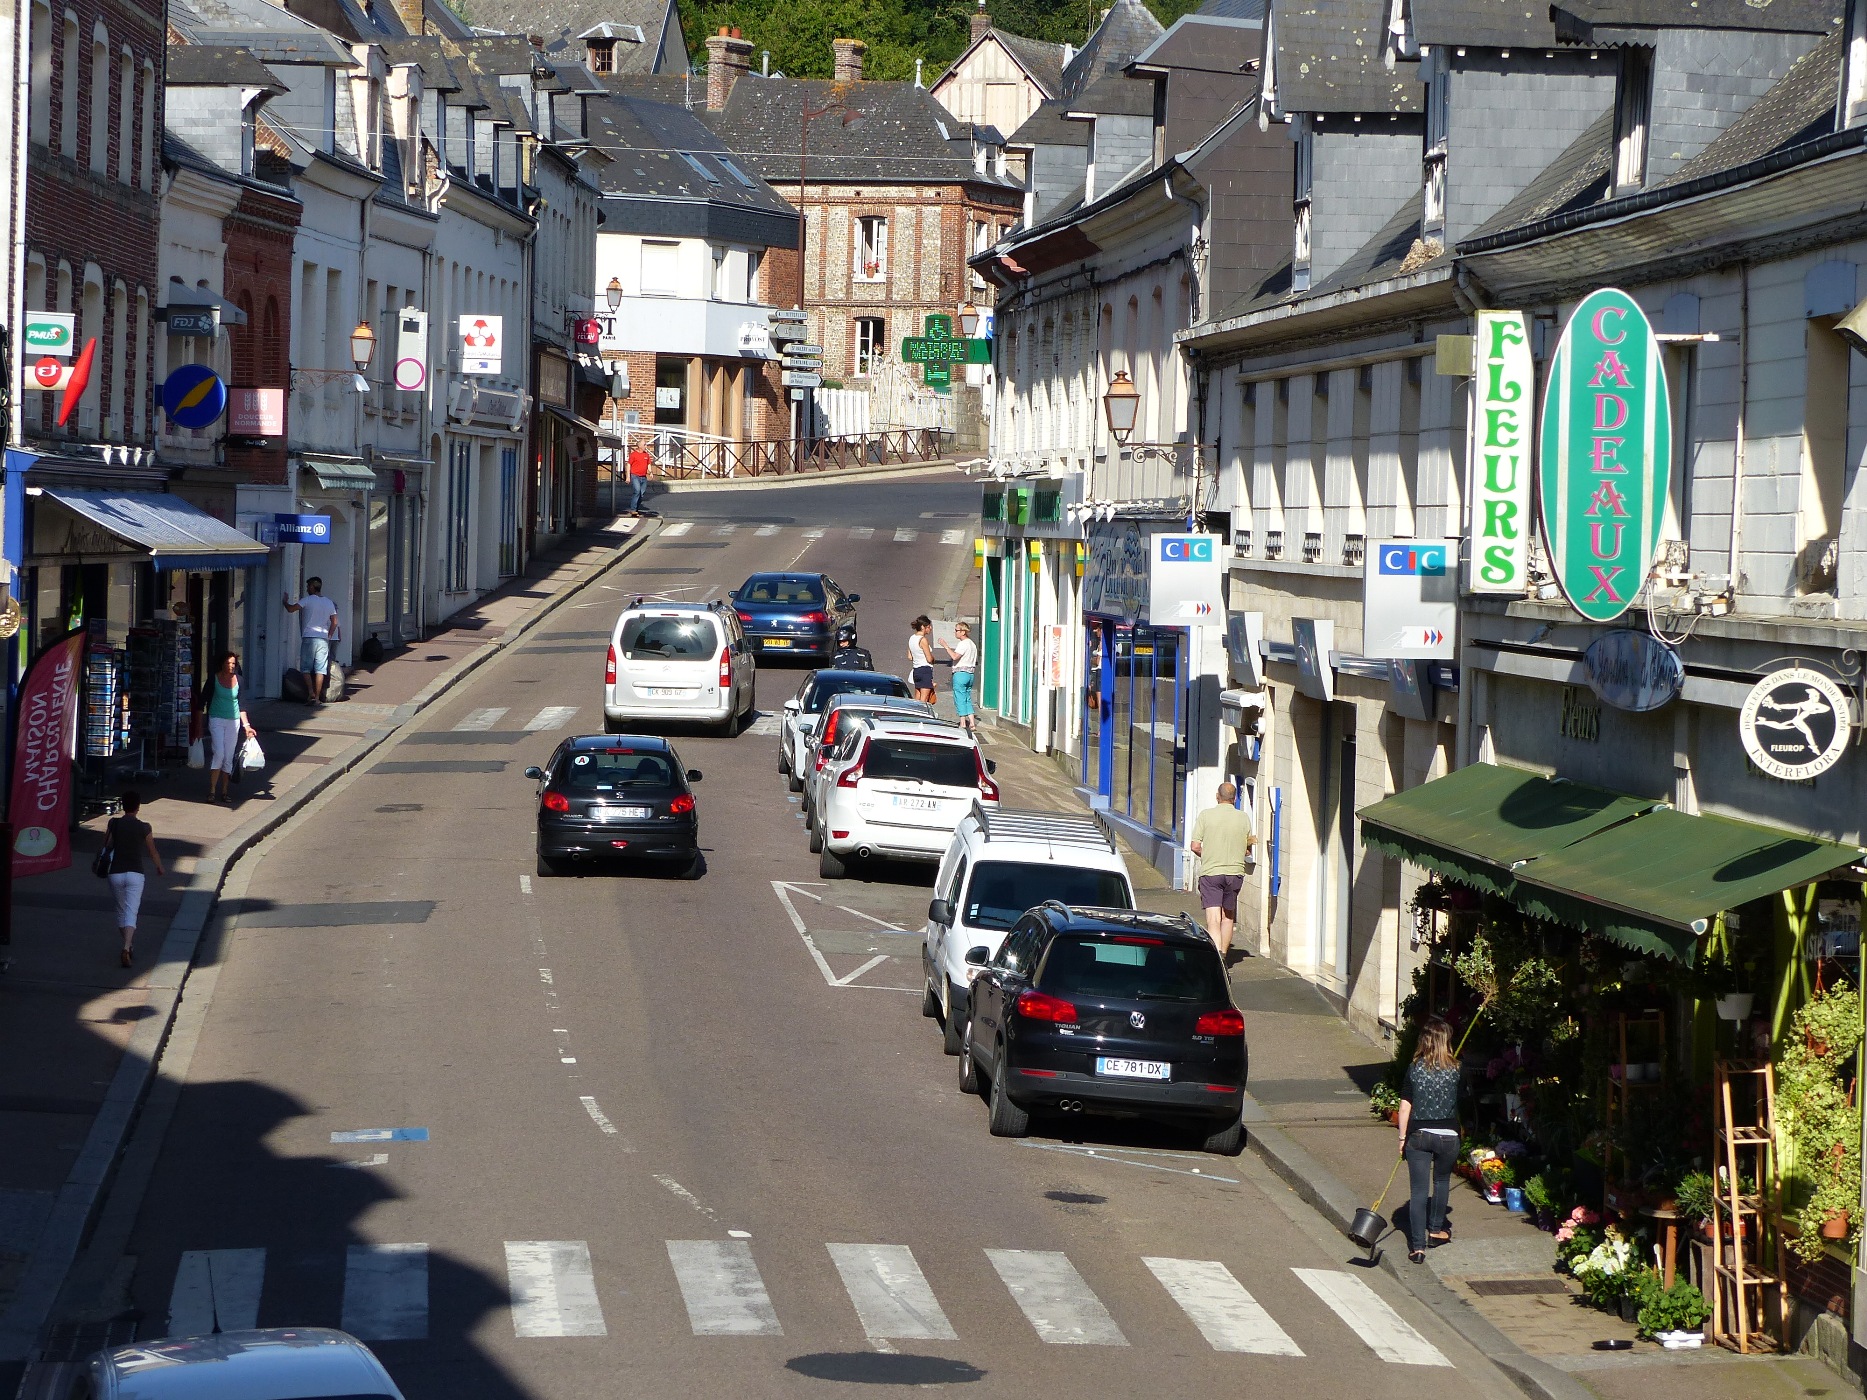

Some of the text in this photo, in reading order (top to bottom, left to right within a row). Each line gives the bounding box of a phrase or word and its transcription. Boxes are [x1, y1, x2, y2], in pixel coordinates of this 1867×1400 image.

[173, 317, 195, 327] FDJ
[234, 420, 278, 428] NORMANDE
[238, 413, 274, 421] DOUCEUR
[1481, 319, 1524, 585] FLEURS
[1582, 306, 1631, 605] CADEAUX
[279, 523, 312, 534] Allianz
[1165, 542, 1207, 558] CIC
[1382, 549, 1440, 571] CIC
[1772, 672, 1795, 684] DANS
[1810, 675, 1839, 700] MONDE
[1559, 686, 1600, 741] Fleurs
[1770, 744, 1805, 752] FLEUROP
[578, 756, 586, 764] A
[1752, 748, 1840, 777] INTERFLORA
